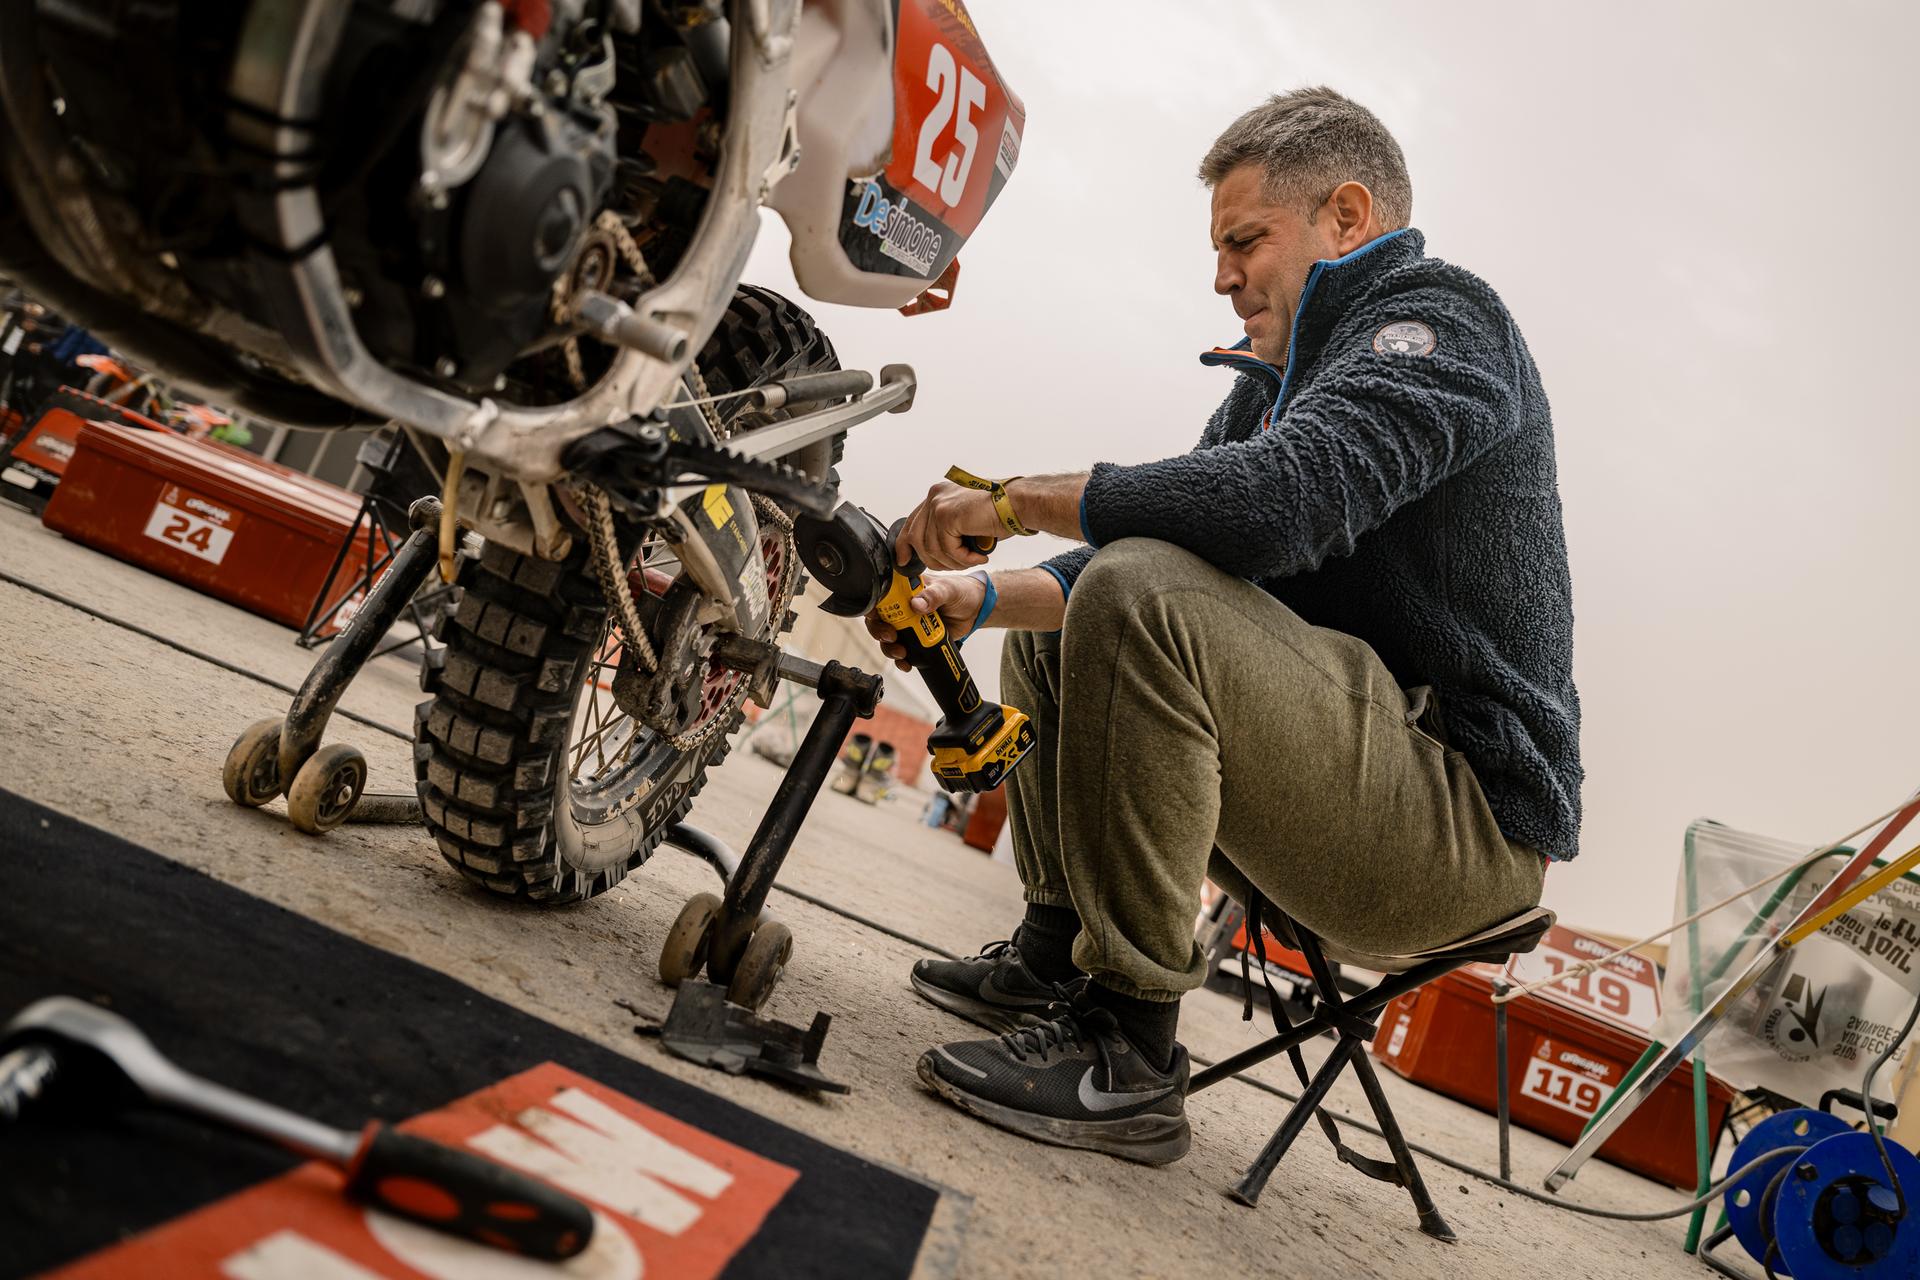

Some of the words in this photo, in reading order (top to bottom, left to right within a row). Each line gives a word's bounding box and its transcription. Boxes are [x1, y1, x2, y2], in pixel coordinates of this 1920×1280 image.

[912, 42, 986, 208] 25
[853, 181, 942, 266] Desimone
[162, 514, 213, 552] 24
[646, 782, 683, 829] RACE
[1544, 956, 1630, 1016] 119
[1531, 1067, 1602, 1114] 119
